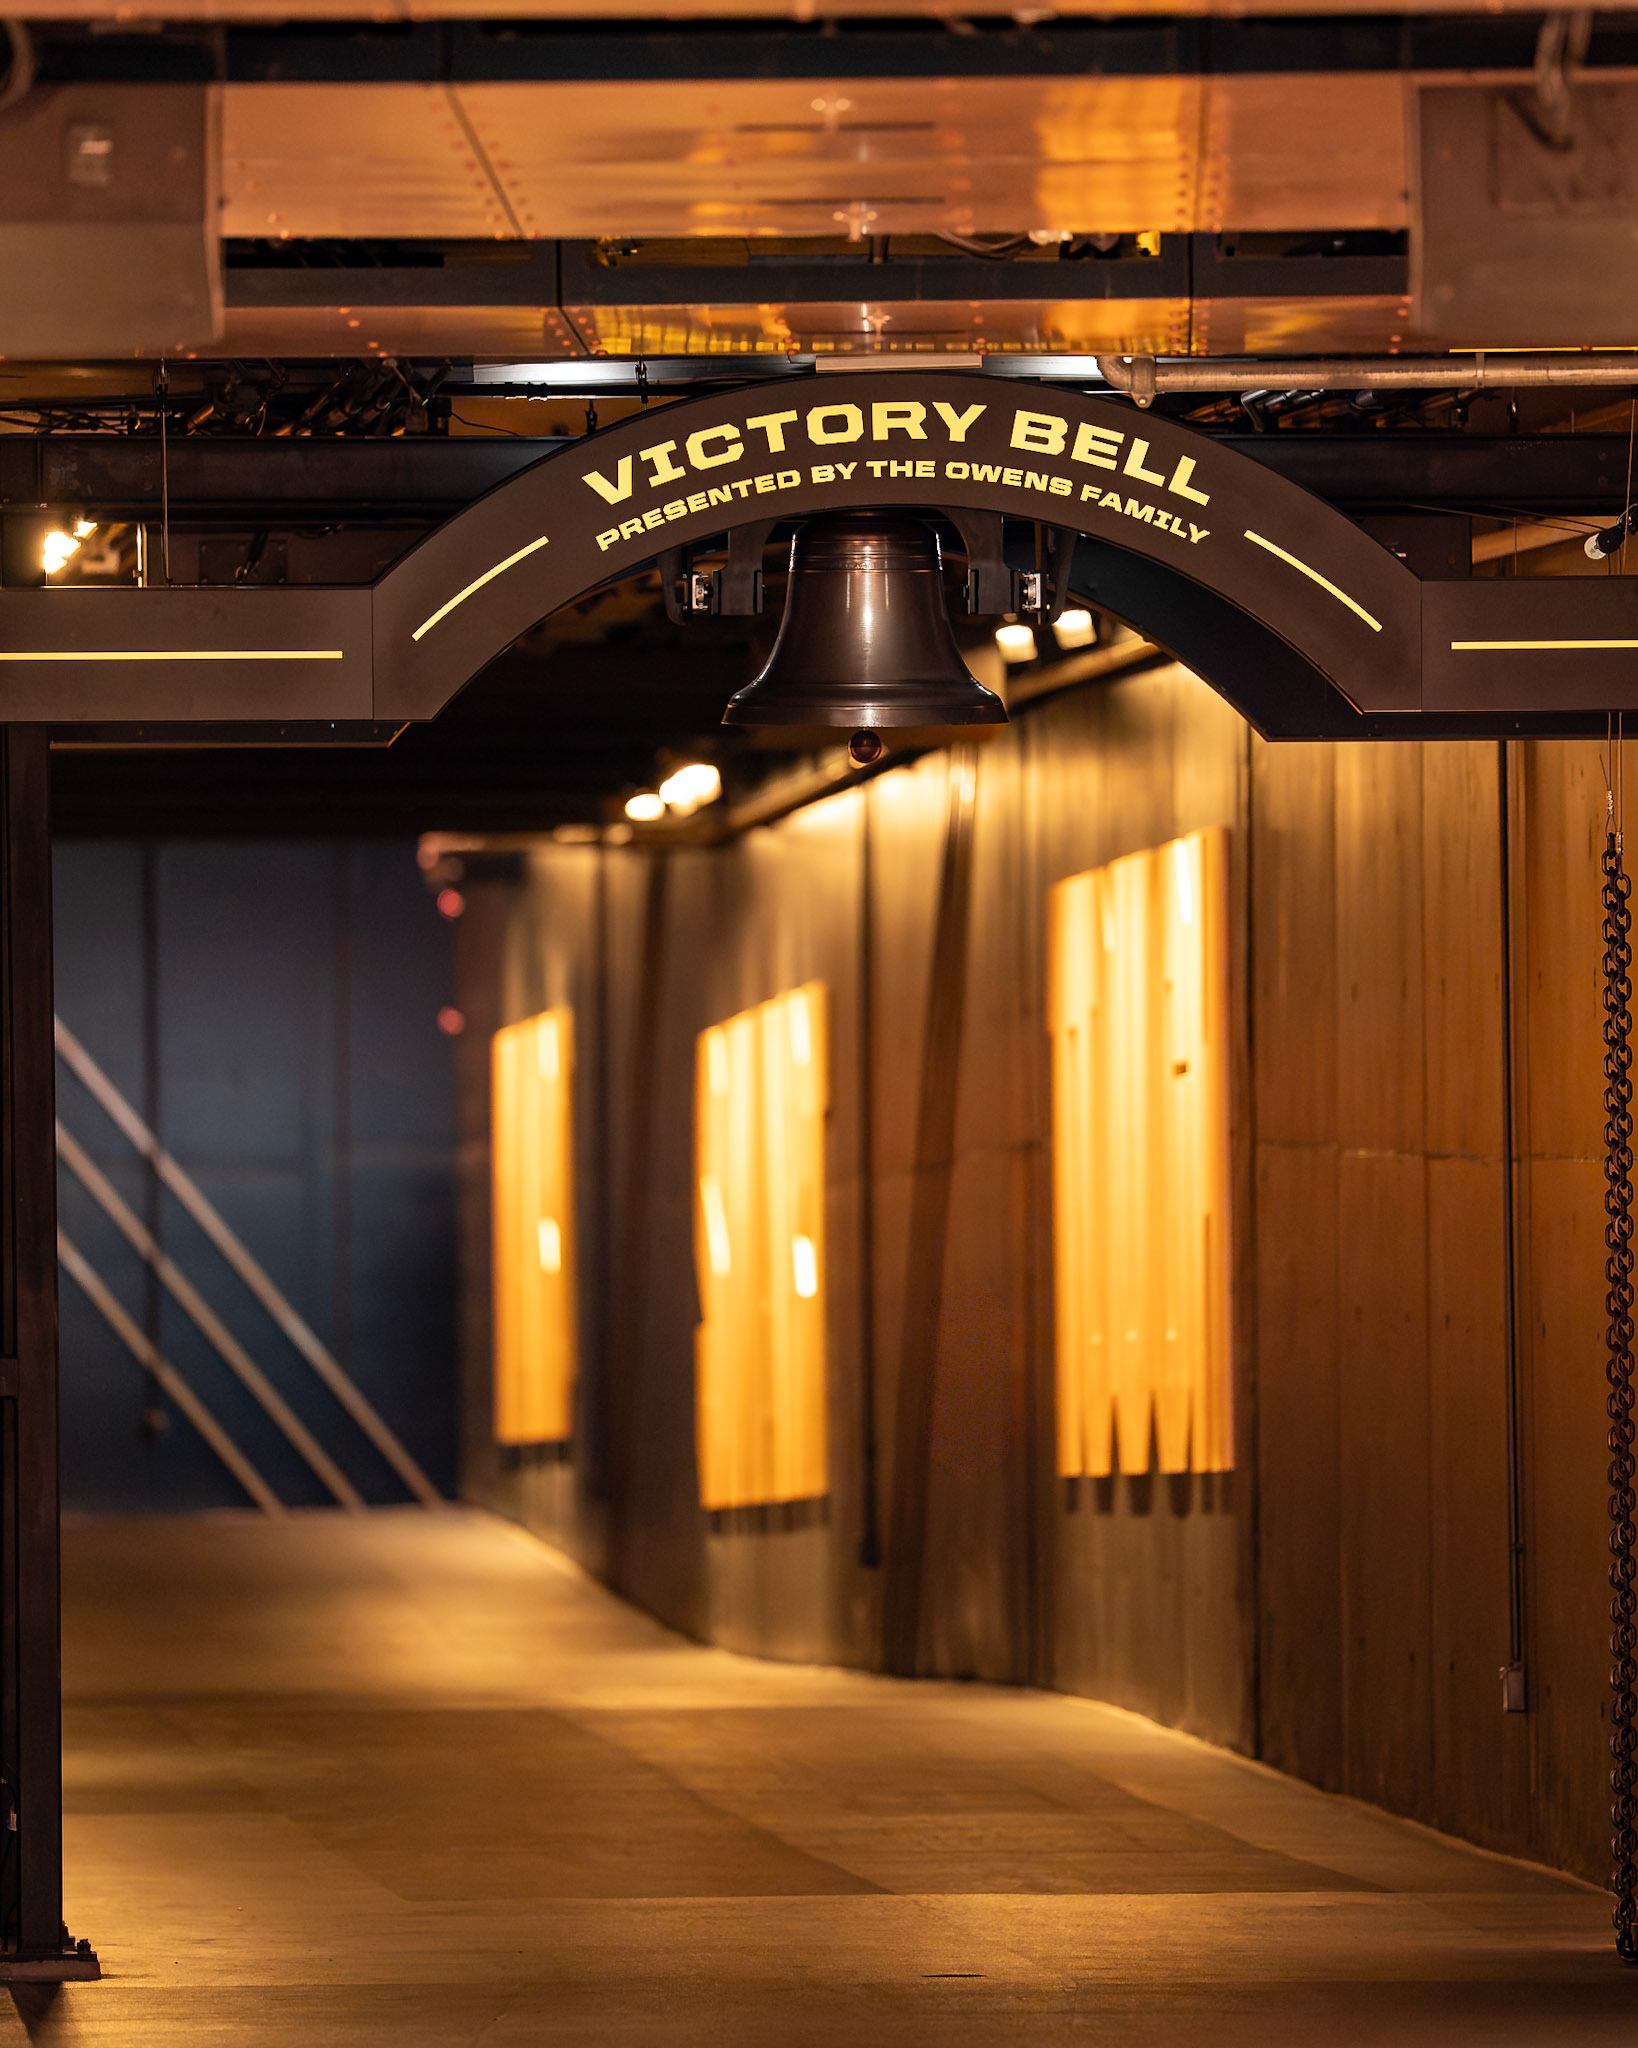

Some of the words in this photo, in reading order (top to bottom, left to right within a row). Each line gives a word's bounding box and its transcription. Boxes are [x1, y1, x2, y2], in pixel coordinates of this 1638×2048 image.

[582, 402, 986, 505] VICTORY
[1009, 409, 1211, 507] BELL
[595, 469, 802, 552] PRESENTED
[810, 461, 858, 484] BY
[865, 460, 936, 478] THE
[944, 461, 1073, 497] OWENS
[1079, 483, 1211, 544] FAMILY
